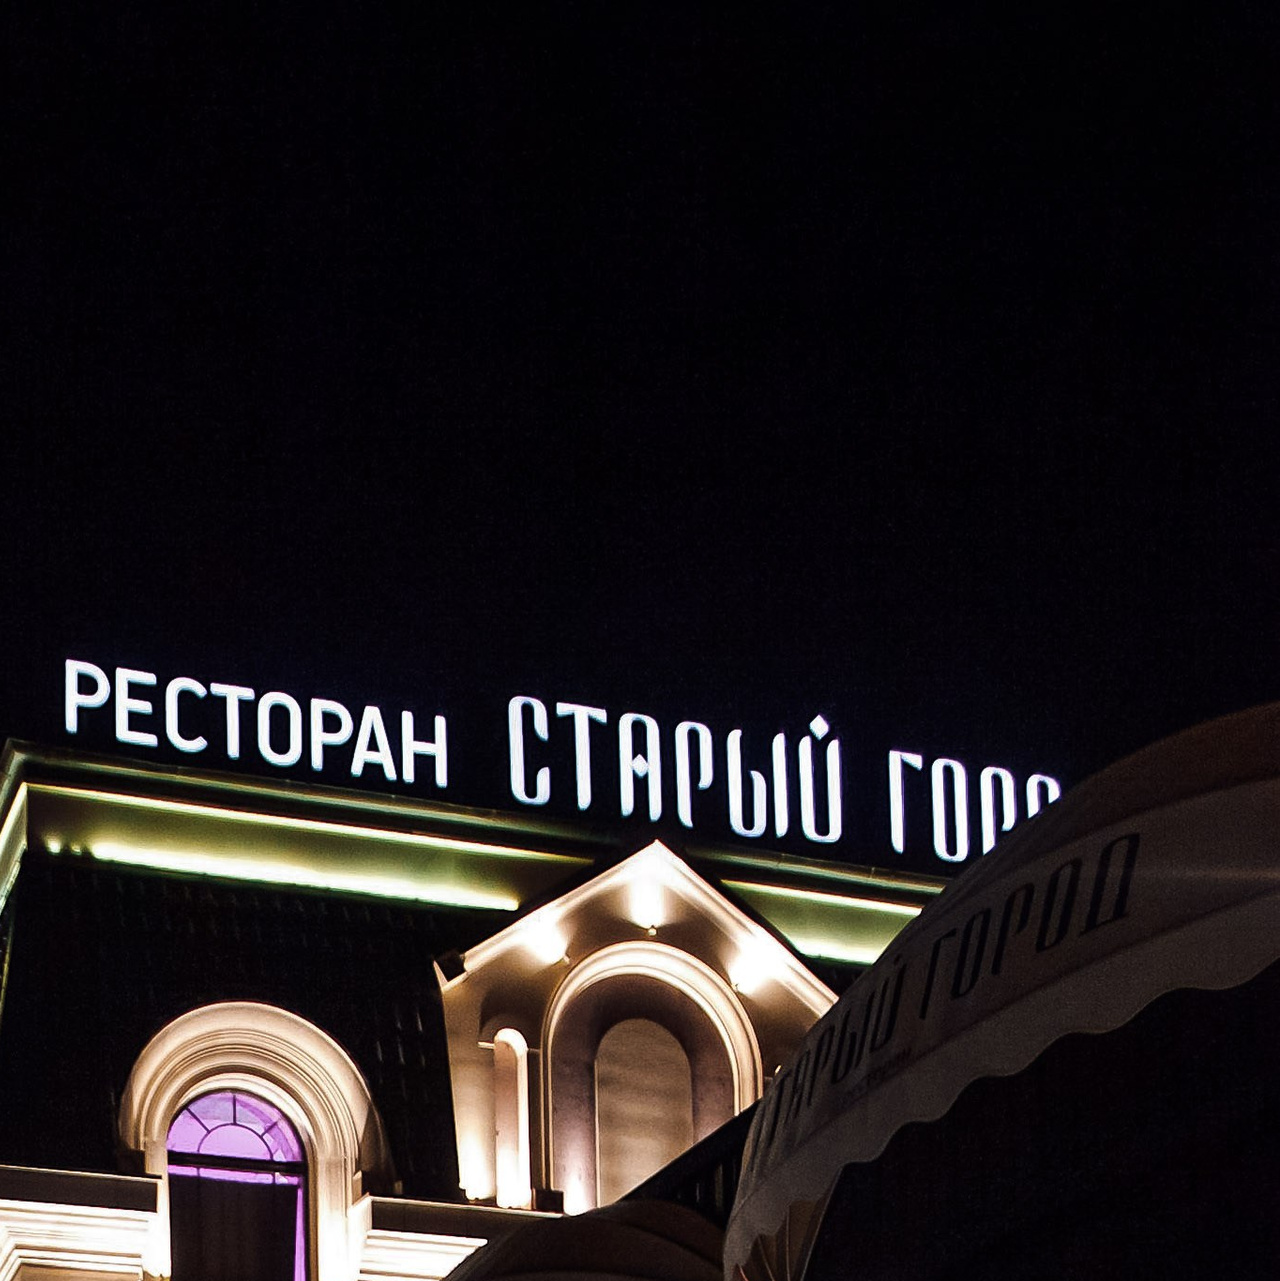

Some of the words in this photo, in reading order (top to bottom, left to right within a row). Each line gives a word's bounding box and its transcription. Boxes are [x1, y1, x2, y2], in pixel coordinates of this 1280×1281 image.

[63, 658, 449, 789] РЕСТОРАН
[507, 694, 843, 844] СТАРЫЙ
[919, 833, 1141, 1020] ГОРОД
